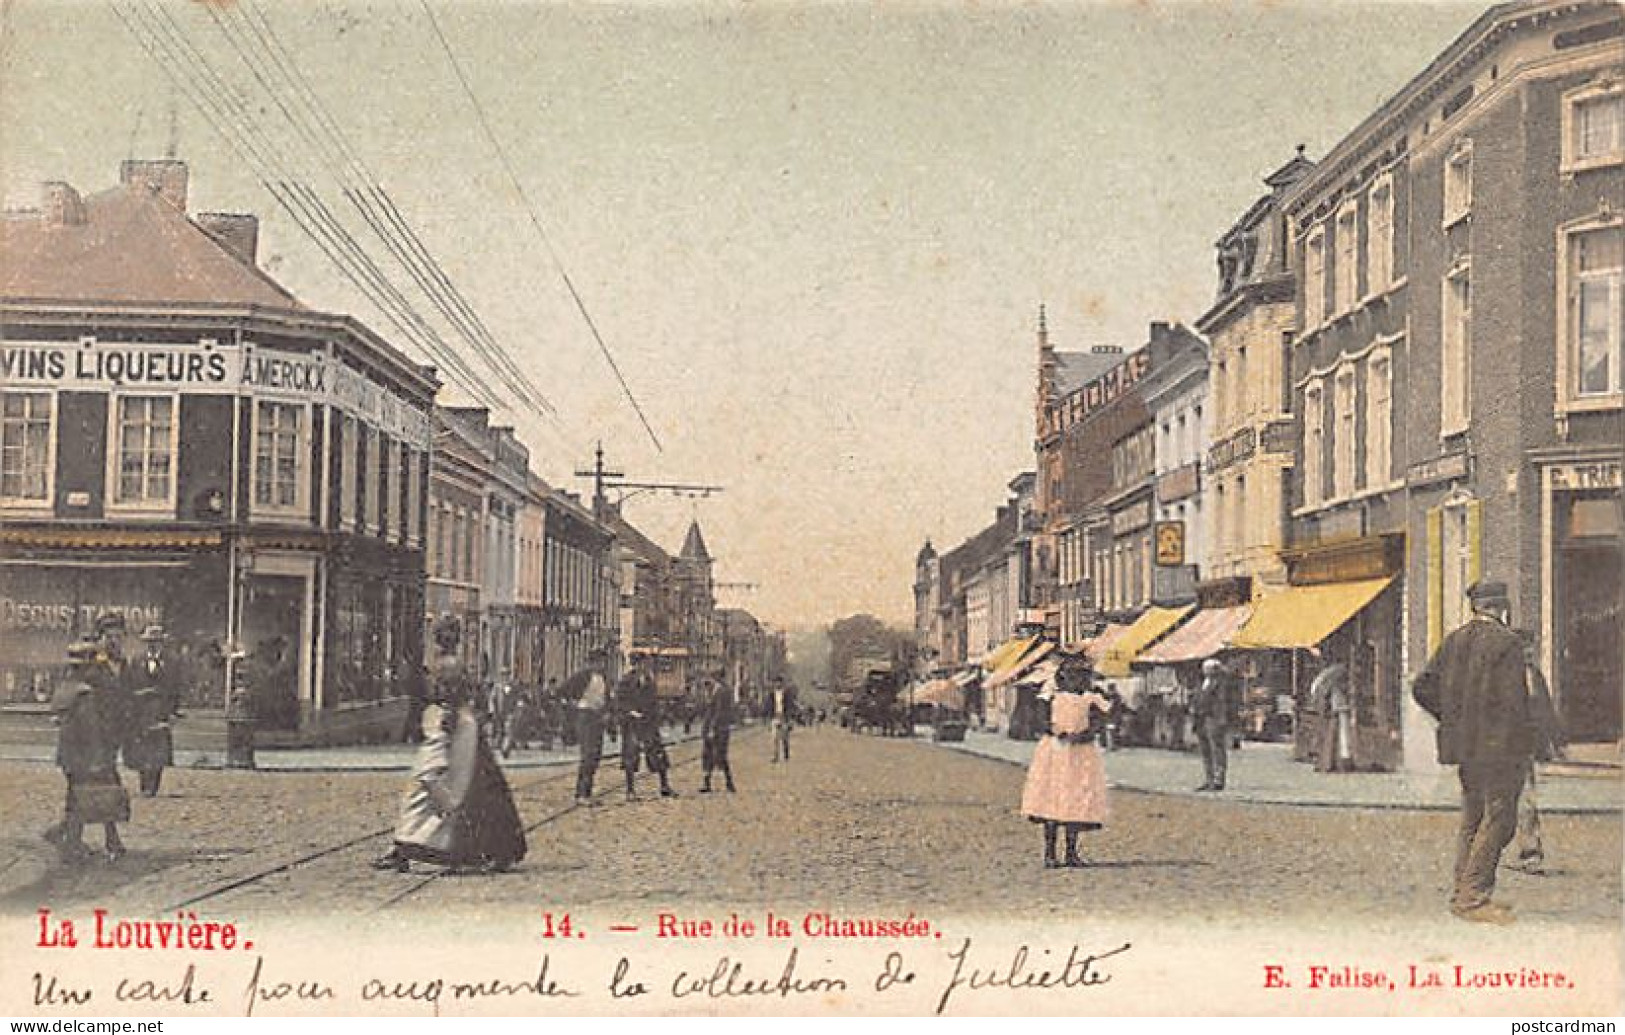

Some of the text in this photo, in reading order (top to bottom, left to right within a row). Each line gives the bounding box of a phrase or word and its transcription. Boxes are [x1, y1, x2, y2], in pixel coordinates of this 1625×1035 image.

[0, 348, 226, 386] VINS LIQUEURS
[936, 937, 1131, 1014] Juliette
